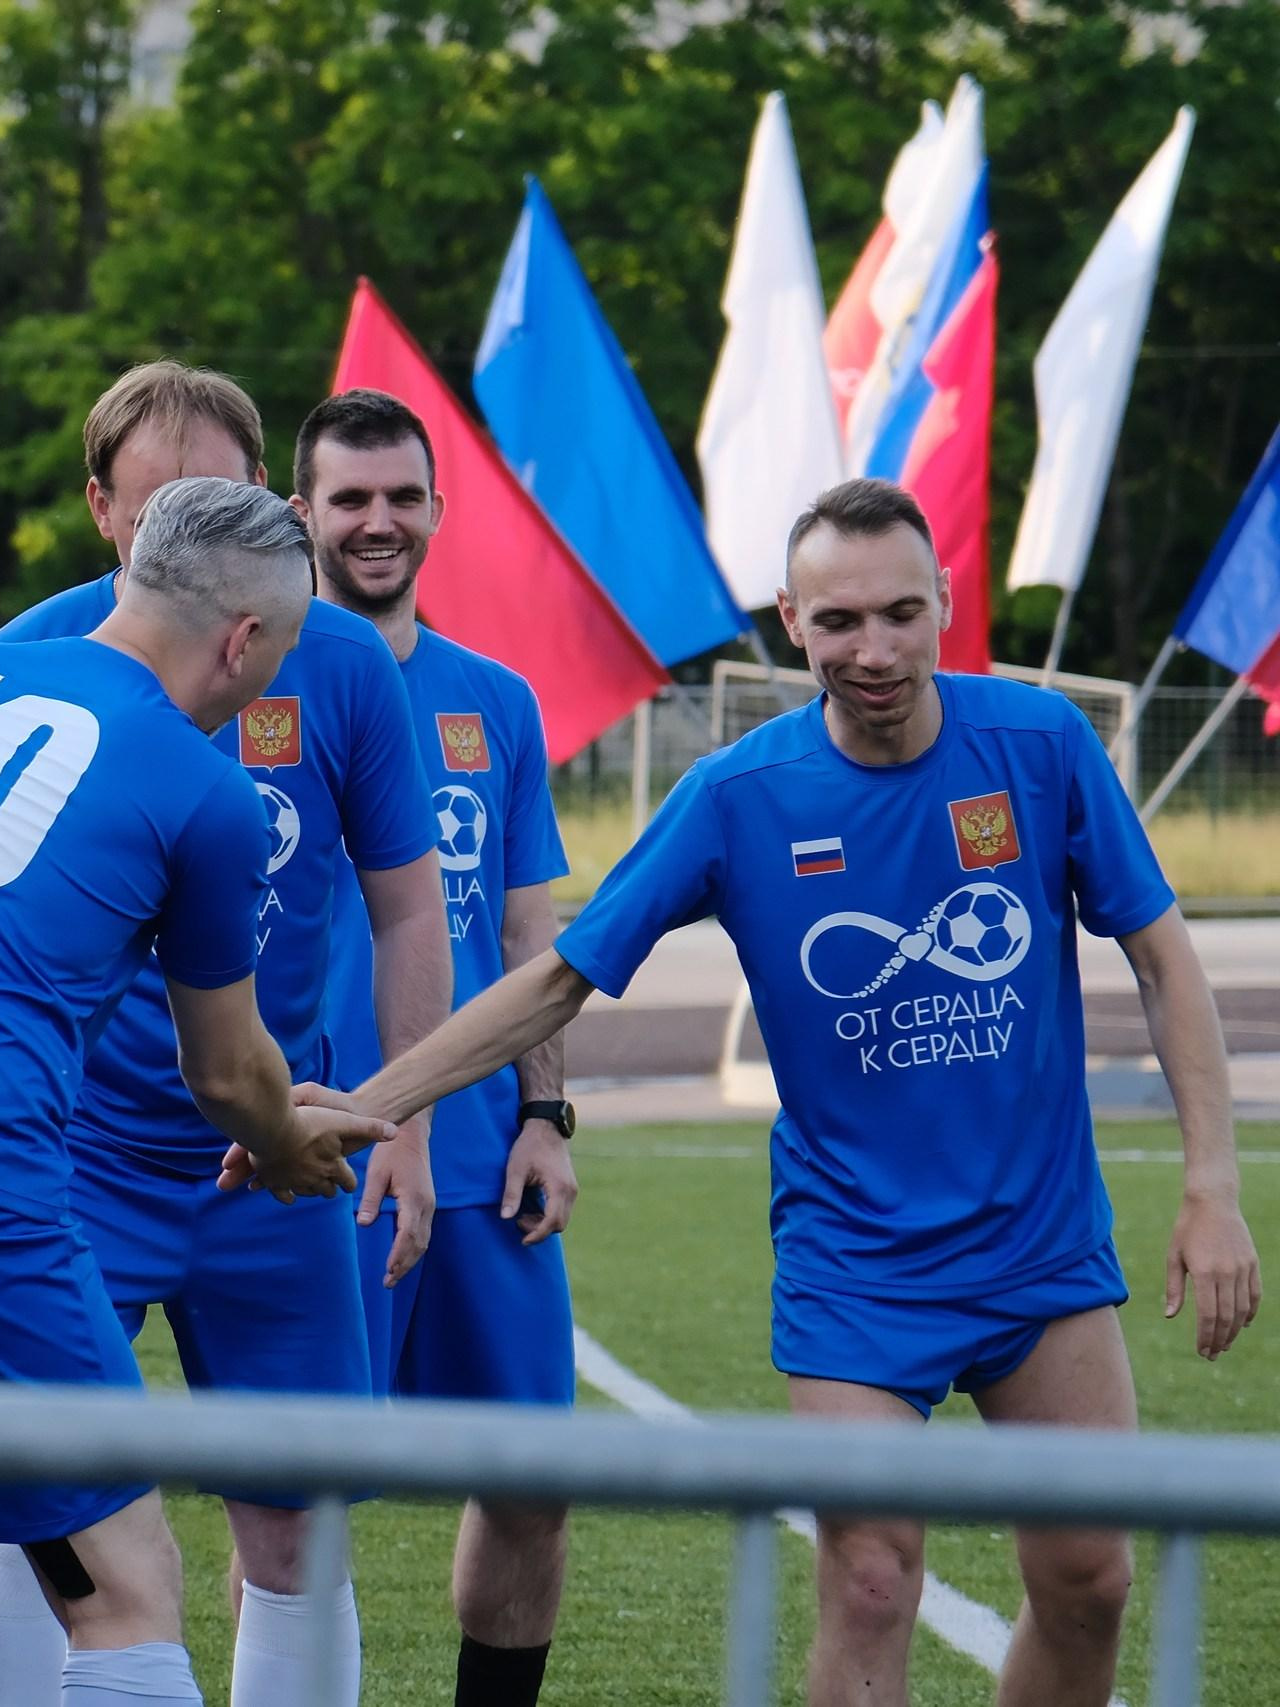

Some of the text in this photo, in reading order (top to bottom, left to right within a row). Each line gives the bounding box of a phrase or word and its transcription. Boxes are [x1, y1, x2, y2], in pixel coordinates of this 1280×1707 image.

[835, 983, 1025, 1041] ОТ СЕРДЦА
[859, 1021, 1014, 1075] К СЕРДЦУ
